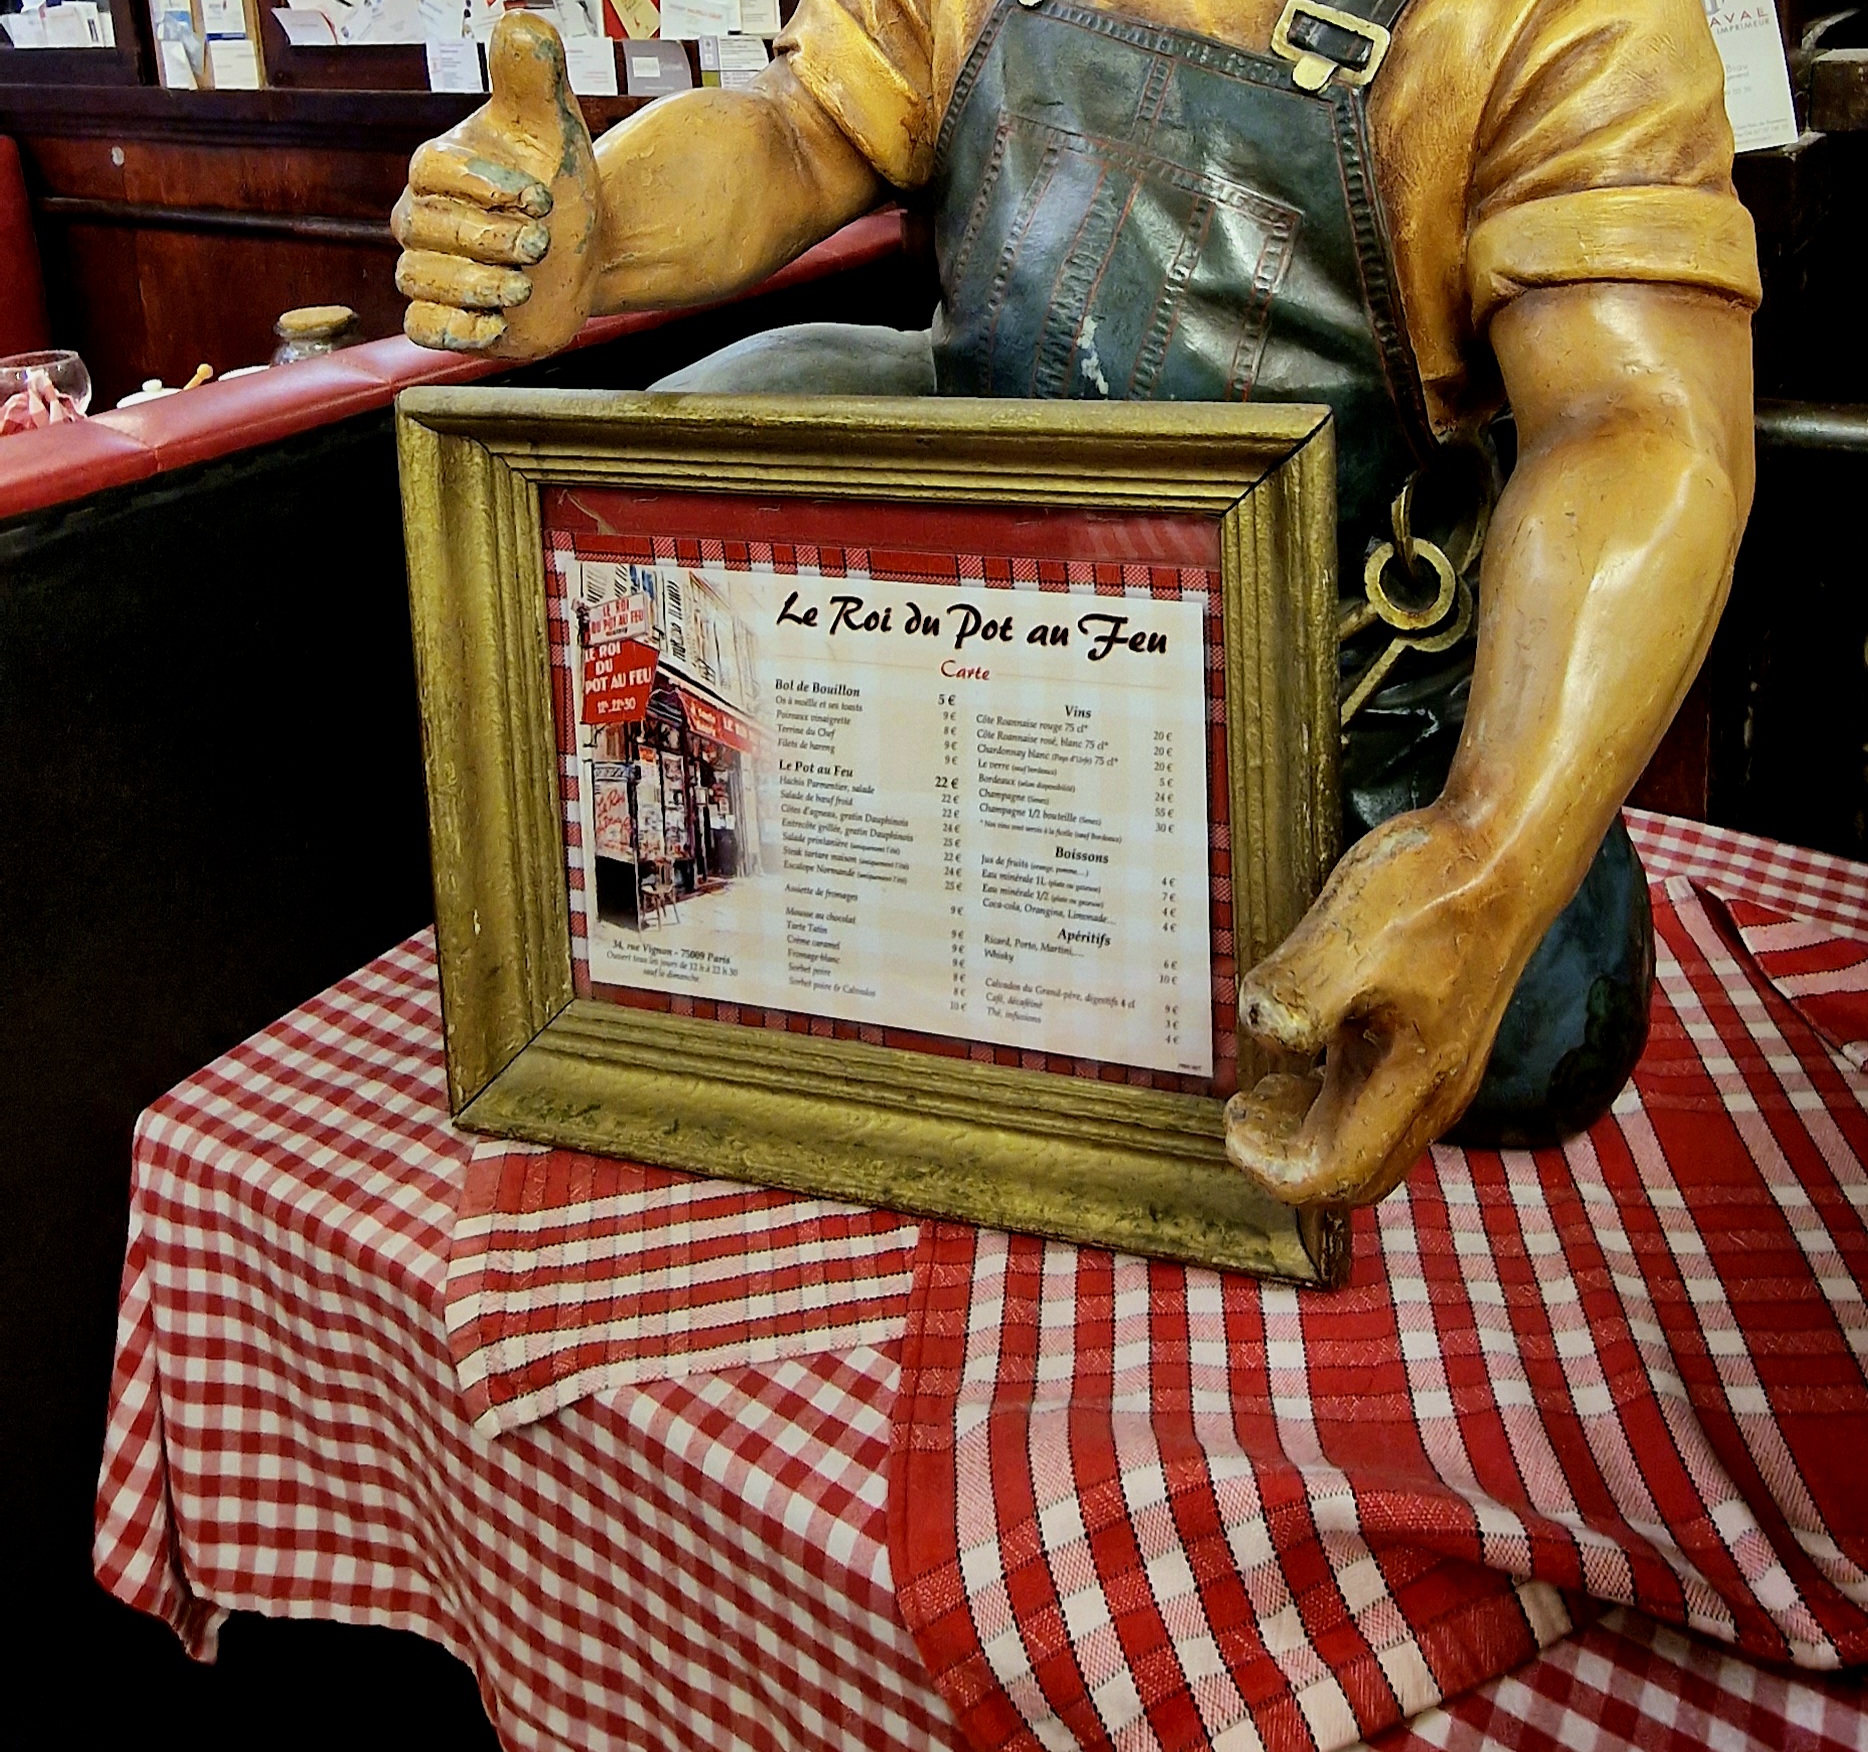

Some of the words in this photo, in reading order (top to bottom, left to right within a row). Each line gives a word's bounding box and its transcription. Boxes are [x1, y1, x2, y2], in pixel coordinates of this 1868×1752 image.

[1716, 17, 1771, 36] IMPRIMEUR
[602, 605, 612, 618] LE
[615, 597, 630, 613] ROI
[630, 608, 644, 624] FEU
[776, 591, 819, 628] Le
[829, 595, 893, 637] Roi
[903, 602, 941, 637] du
[946, 603, 1015, 650] Pot
[1026, 623, 1070, 647] au
[1077, 612, 1169, 662] Feu
[584, 648, 596, 663] LE
[598, 640, 622, 659] ROI
[595, 659, 614, 676] DU
[940, 659, 992, 682] Carte
[585, 676, 608, 695] POT
[610, 672, 627, 690] AU
[629, 666, 652, 685] FEU
[775, 678, 793, 690] Bol
[796, 680, 809, 692] de
[812, 681, 859, 696] Bouillon
[937, 693, 944, 705] 5
[947, 694, 955, 706] €
[1065, 704, 1091, 718] Vins
[777, 723, 804, 734] Terrine
[805, 726, 815, 735] du
[817, 727, 836, 740] Chef
[1039, 722, 1062, 733] rouge
[1064, 722, 1074, 732] 75
[1060, 736, 1082, 748] blanc
[1085, 739, 1095, 749] 75
[1027, 748, 1049, 759] blanc
[779, 758, 791, 770] Le
[794, 760, 814, 773] Pot
[816, 766, 830, 775] au
[833, 764, 852, 777] Feu
[977, 758, 987, 768] Le
[988, 761, 1009, 770] verre
[851, 784, 874, 794] salade
[934, 775, 947, 788] 22
[950, 777, 958, 789] €
[978, 787, 1025, 803] Champagne
[979, 802, 1025, 818] Champagne
[1028, 807, 1040, 818] 1/2
[1042, 809, 1076, 822] bouteille
[1055, 846, 1108, 863] Boissons
[1005, 857, 1028, 869] fruits
[825, 912, 855, 924] chocolat
[1057, 928, 1110, 947] Apéritifs
[707, 952, 730, 964] Paris
